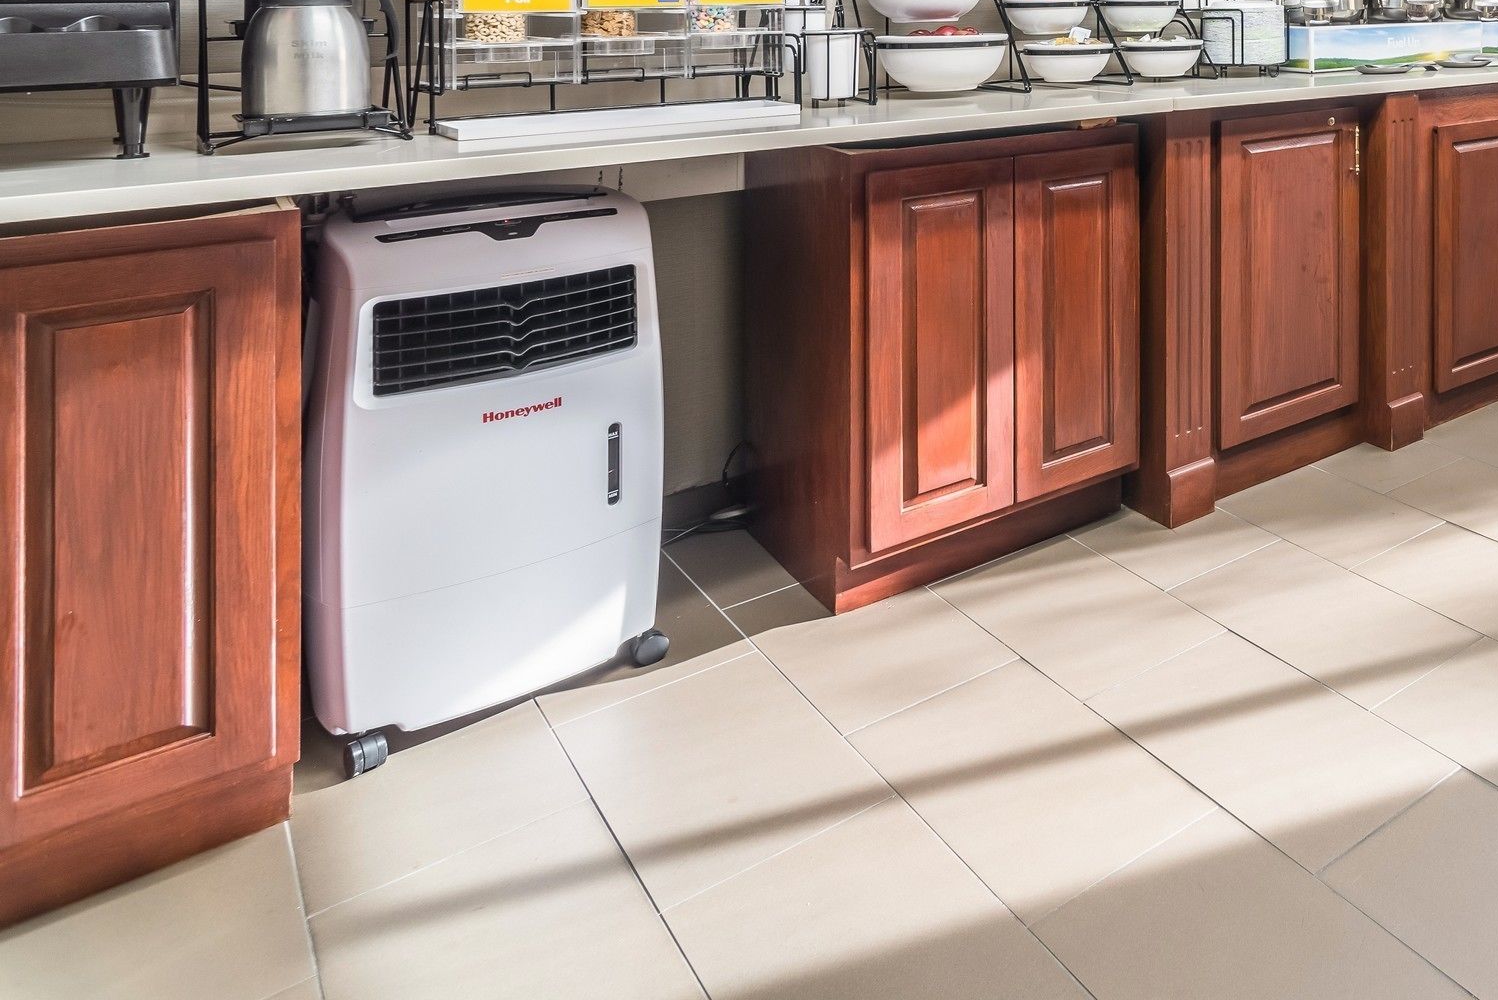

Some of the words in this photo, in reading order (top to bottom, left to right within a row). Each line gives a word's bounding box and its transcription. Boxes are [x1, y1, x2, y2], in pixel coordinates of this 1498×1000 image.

[291, 40, 327, 48] Skim
[293, 51, 324, 59] Milk
[482, 397, 563, 424] Honeywell
